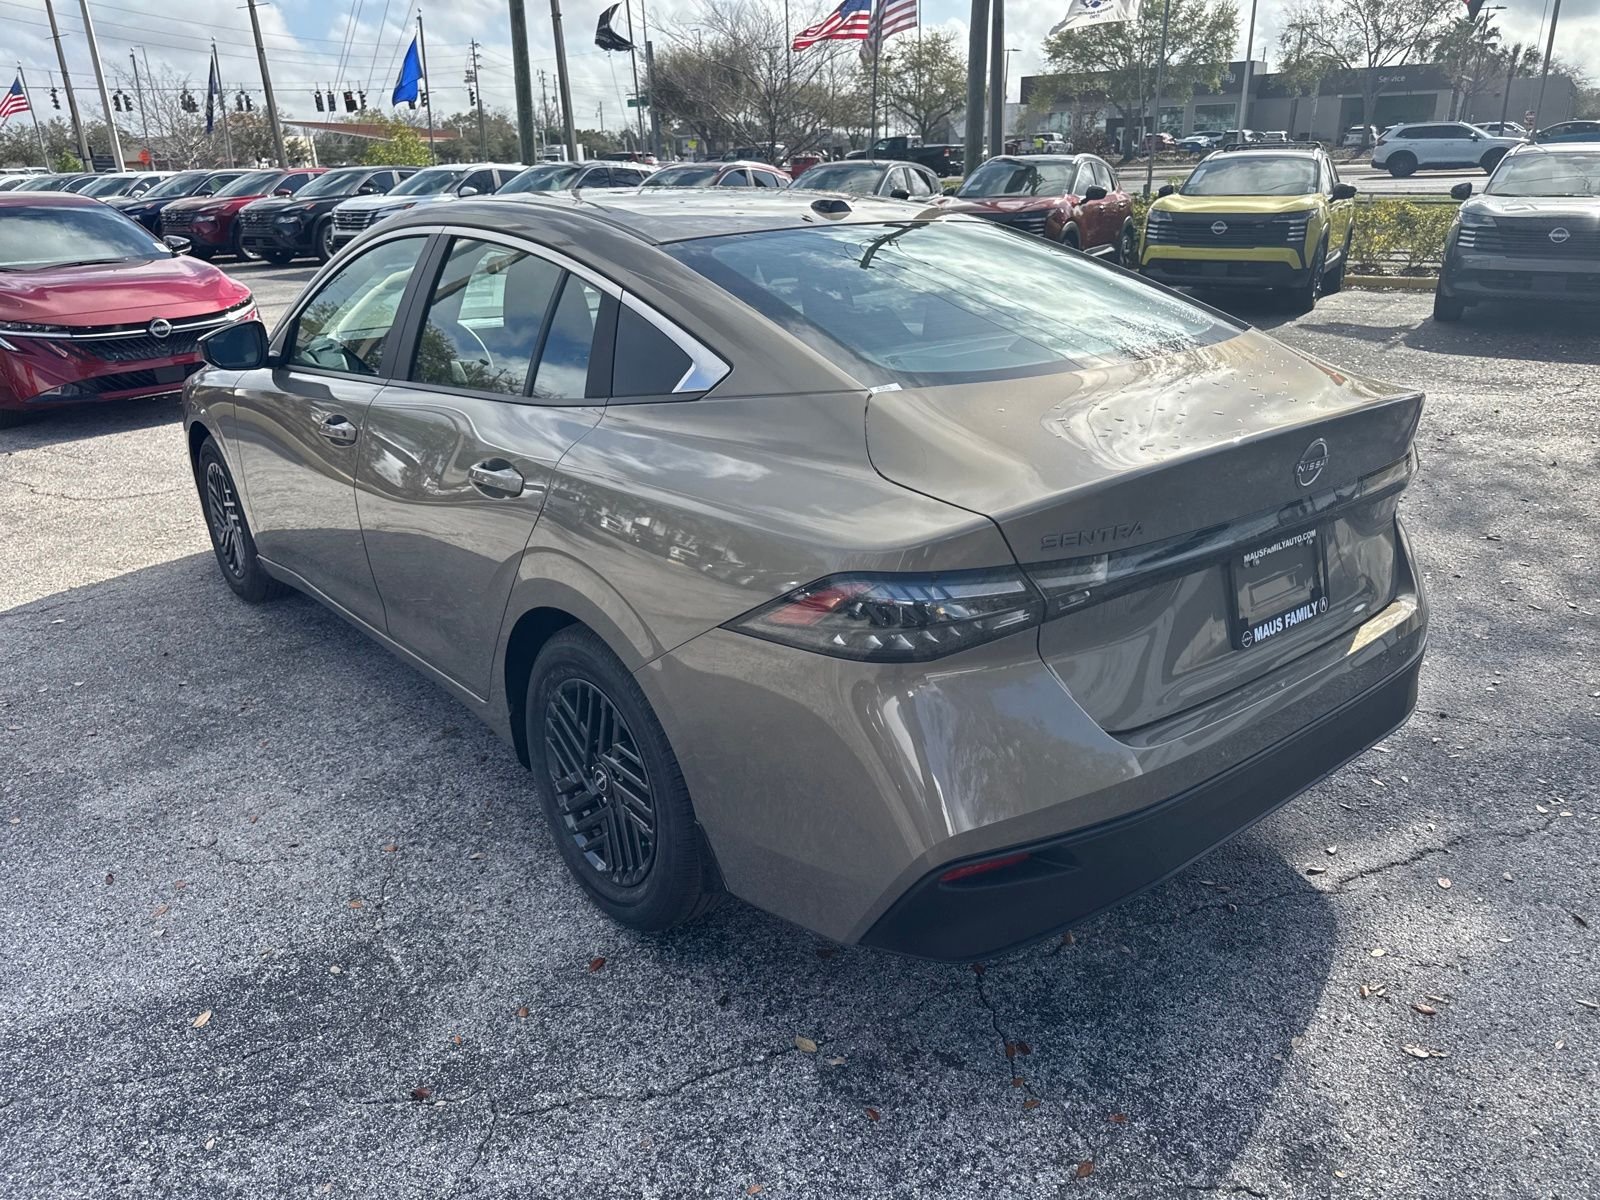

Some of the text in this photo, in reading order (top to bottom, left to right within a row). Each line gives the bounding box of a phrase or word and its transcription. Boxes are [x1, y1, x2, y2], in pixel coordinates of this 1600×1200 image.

[1041, 520, 1143, 551] SENTRA
[1254, 601, 1318, 643] MAUS FAMILY
